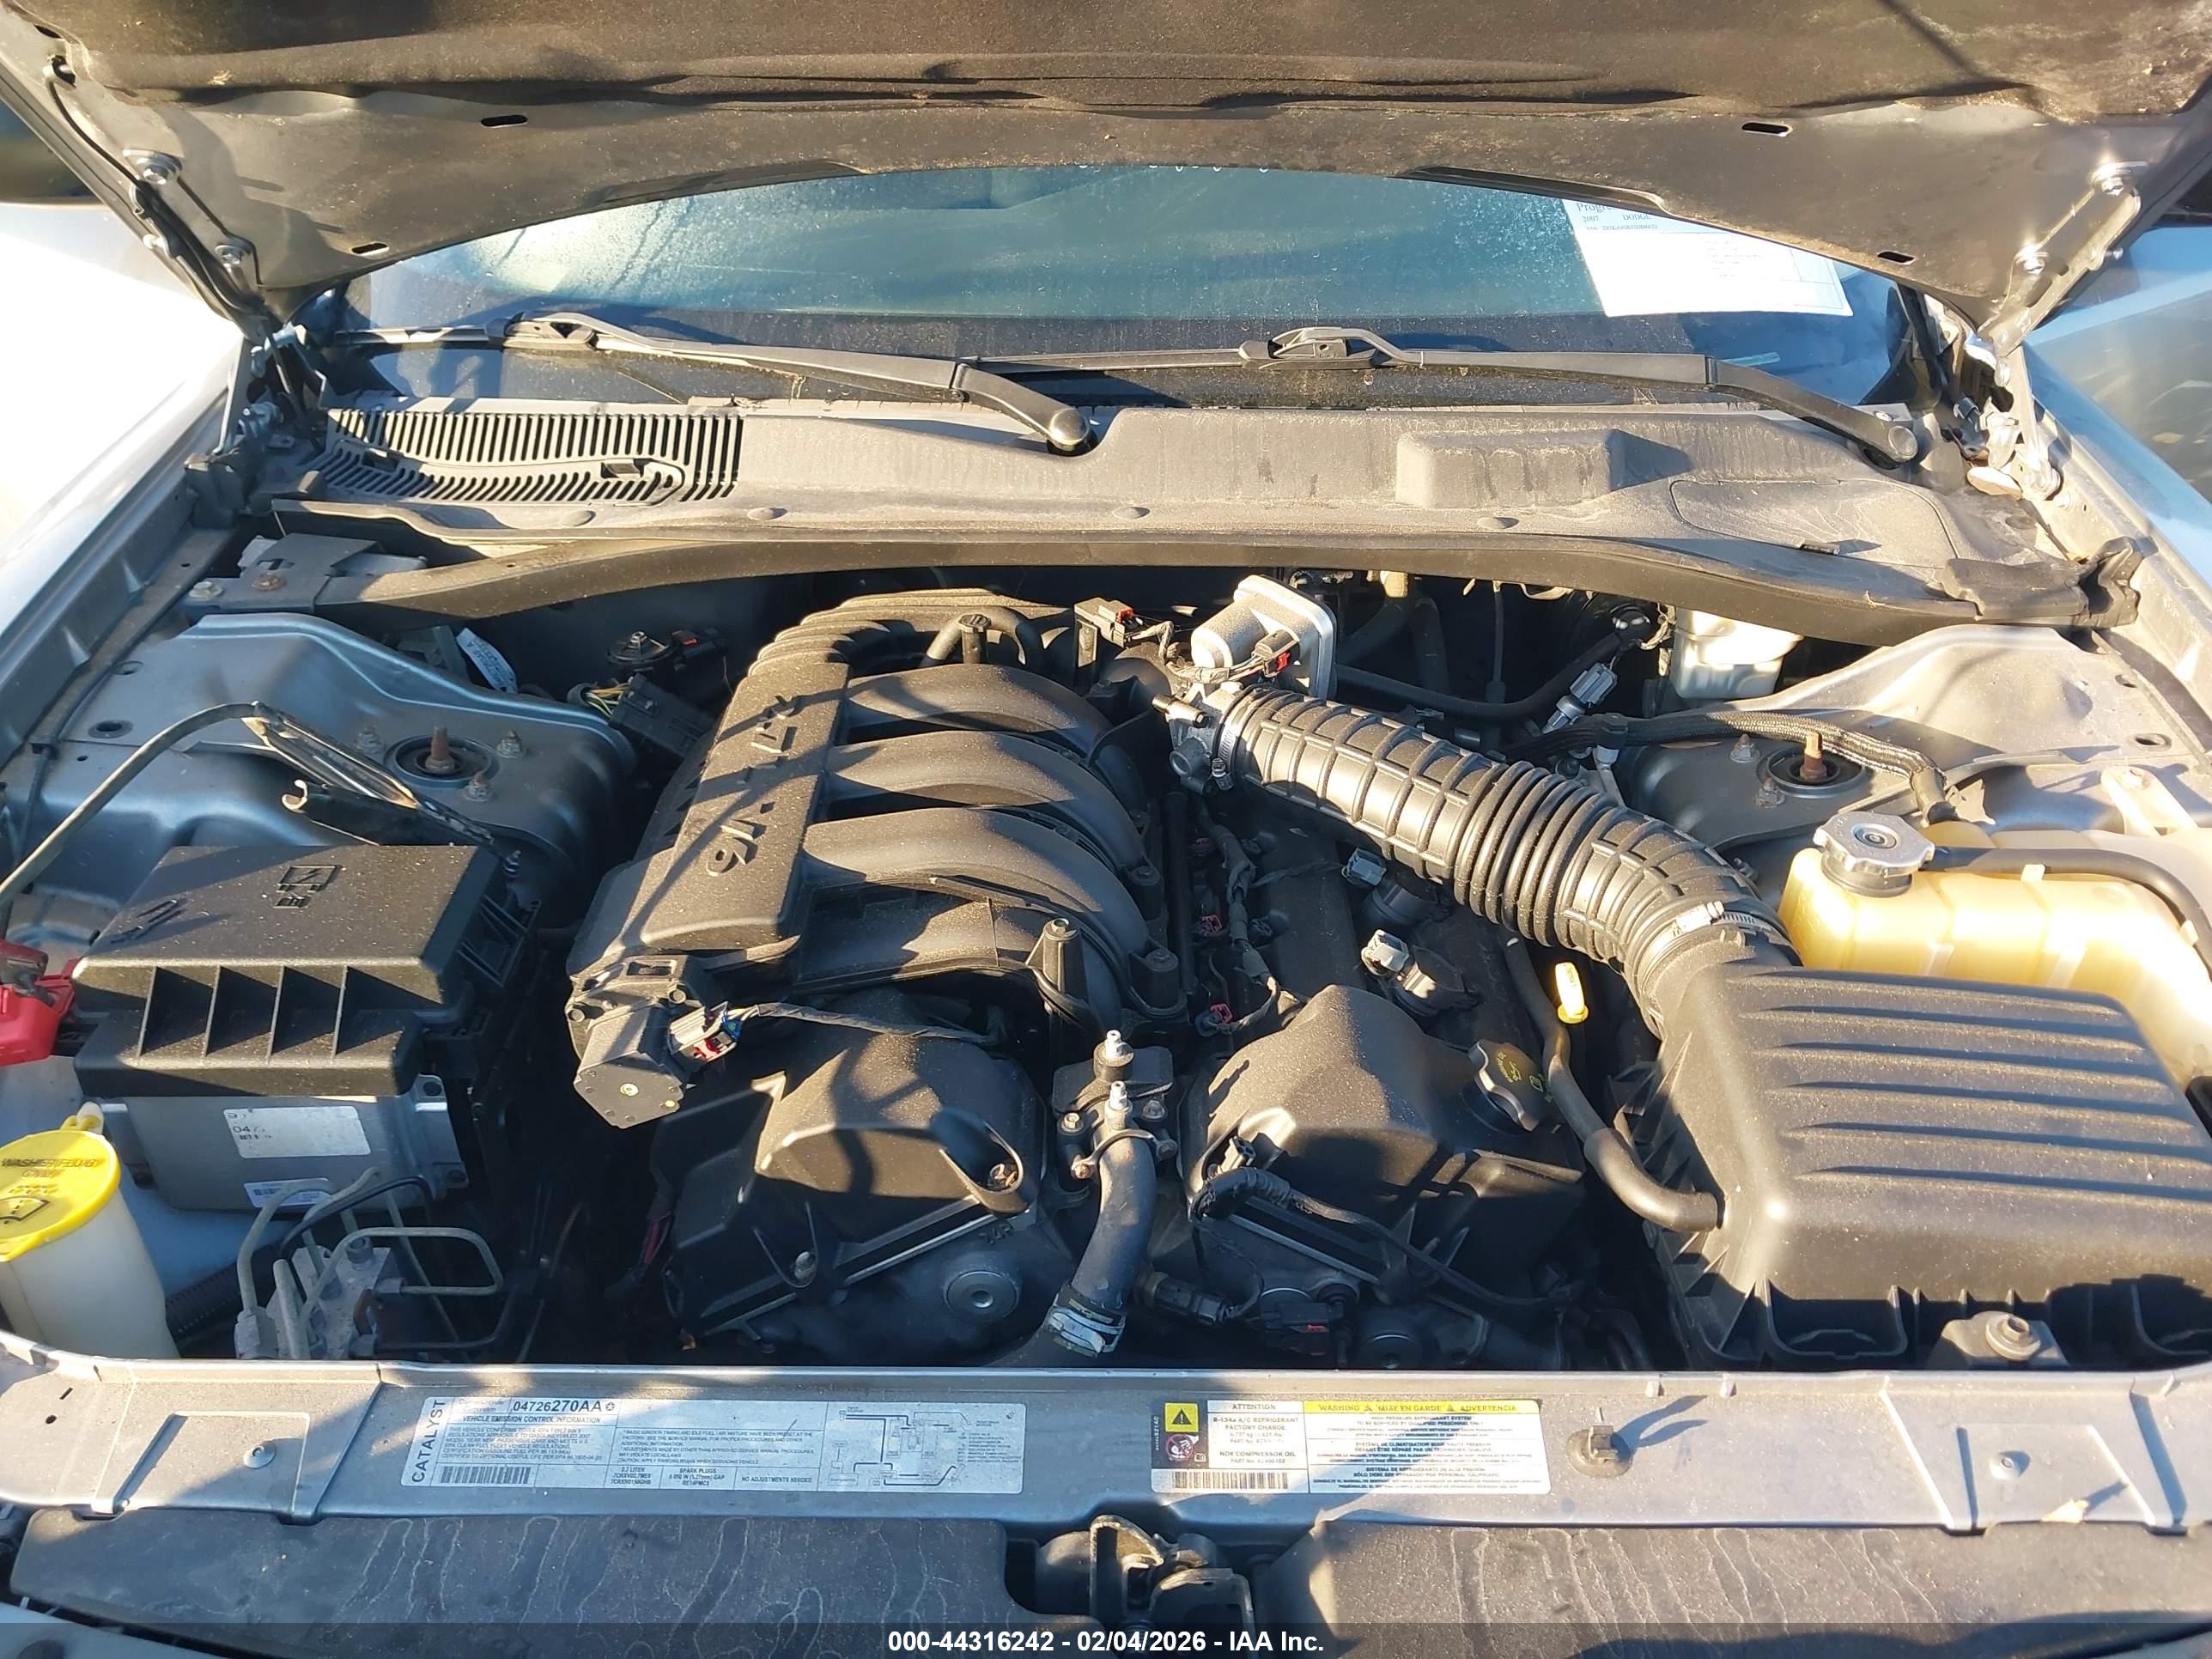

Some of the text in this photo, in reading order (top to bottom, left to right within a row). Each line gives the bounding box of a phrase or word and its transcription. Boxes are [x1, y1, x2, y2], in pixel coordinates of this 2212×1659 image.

[1583, 214, 1599, 222] 2007
[513, 1400, 603, 1413] 04726270AA
[412, 1399, 446, 1483] CATALYST
